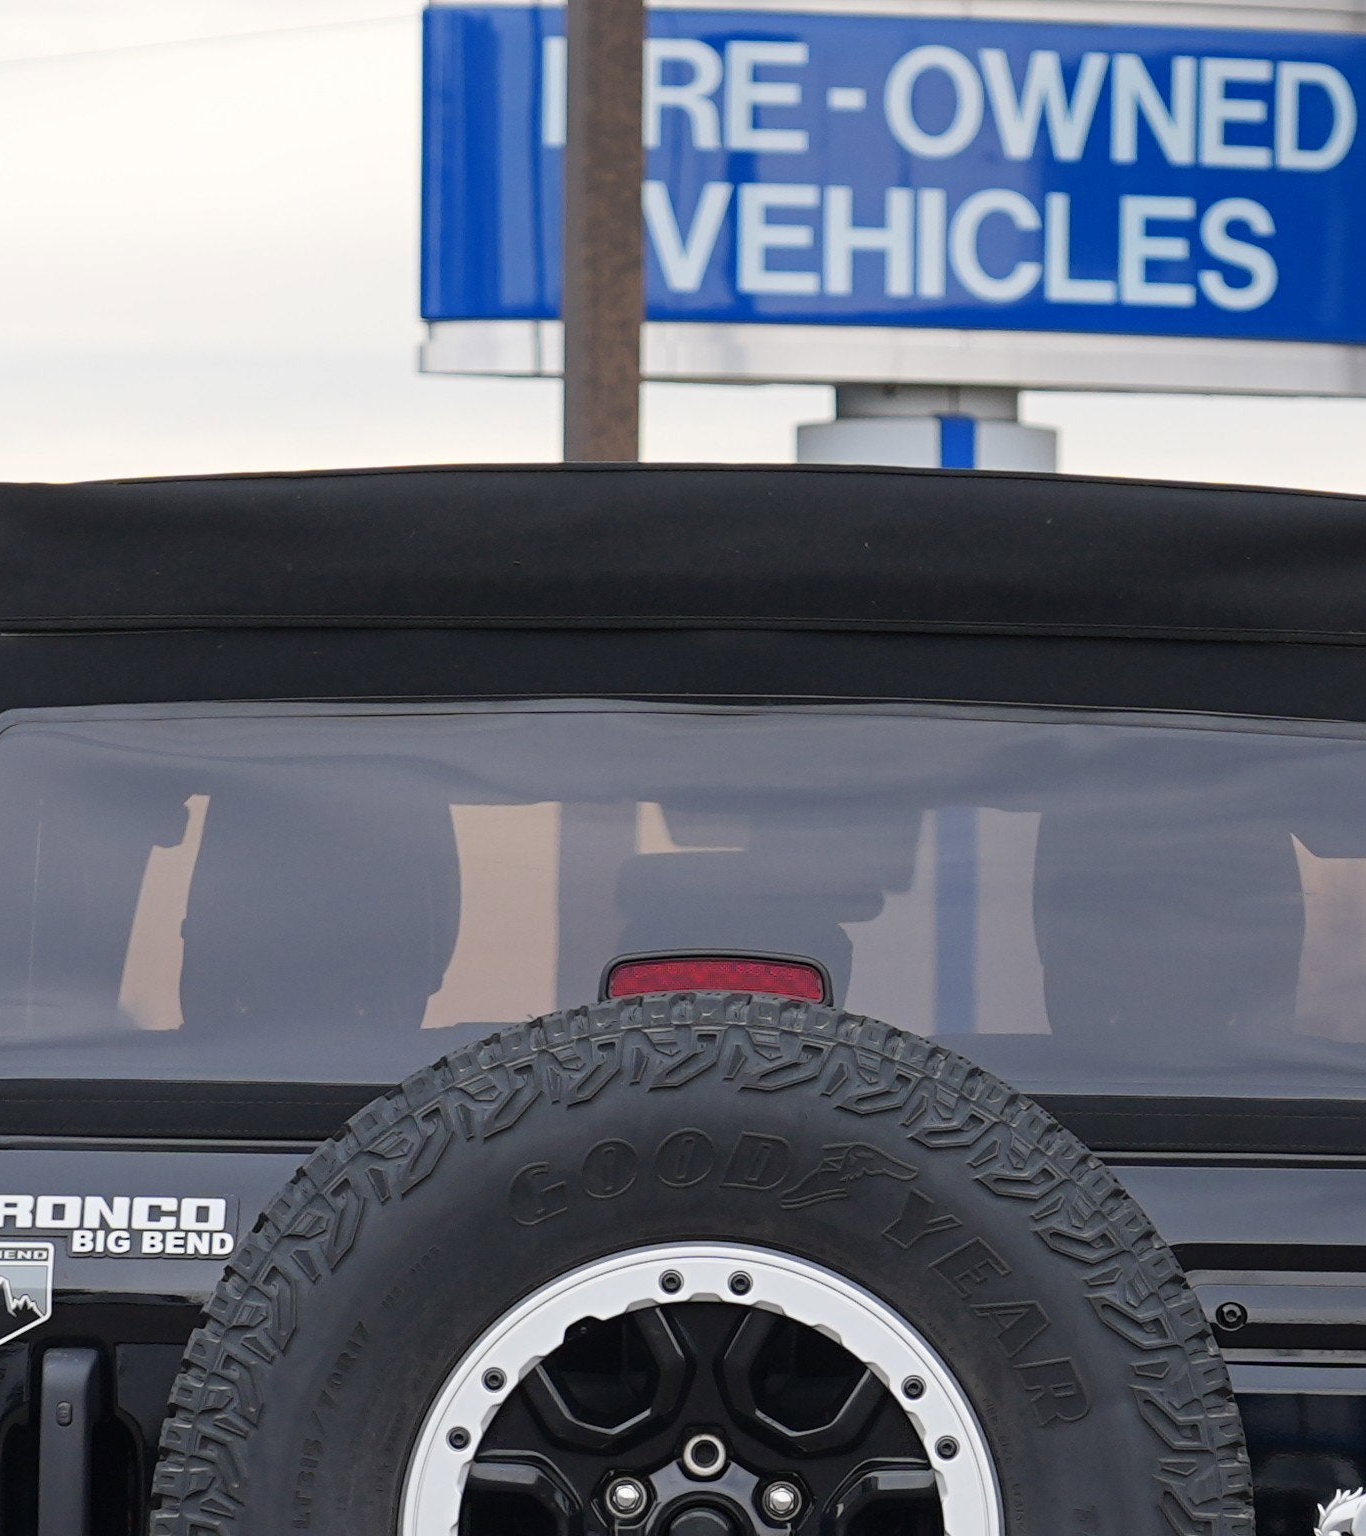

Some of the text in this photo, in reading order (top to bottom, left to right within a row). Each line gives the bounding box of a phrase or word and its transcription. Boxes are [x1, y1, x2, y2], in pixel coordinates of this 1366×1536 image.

[542, 36, 1357, 171] RE-OWNED
[642, 180, 1278, 311] VEHICLES
[71, 1229, 235, 1256] BIG BEND
